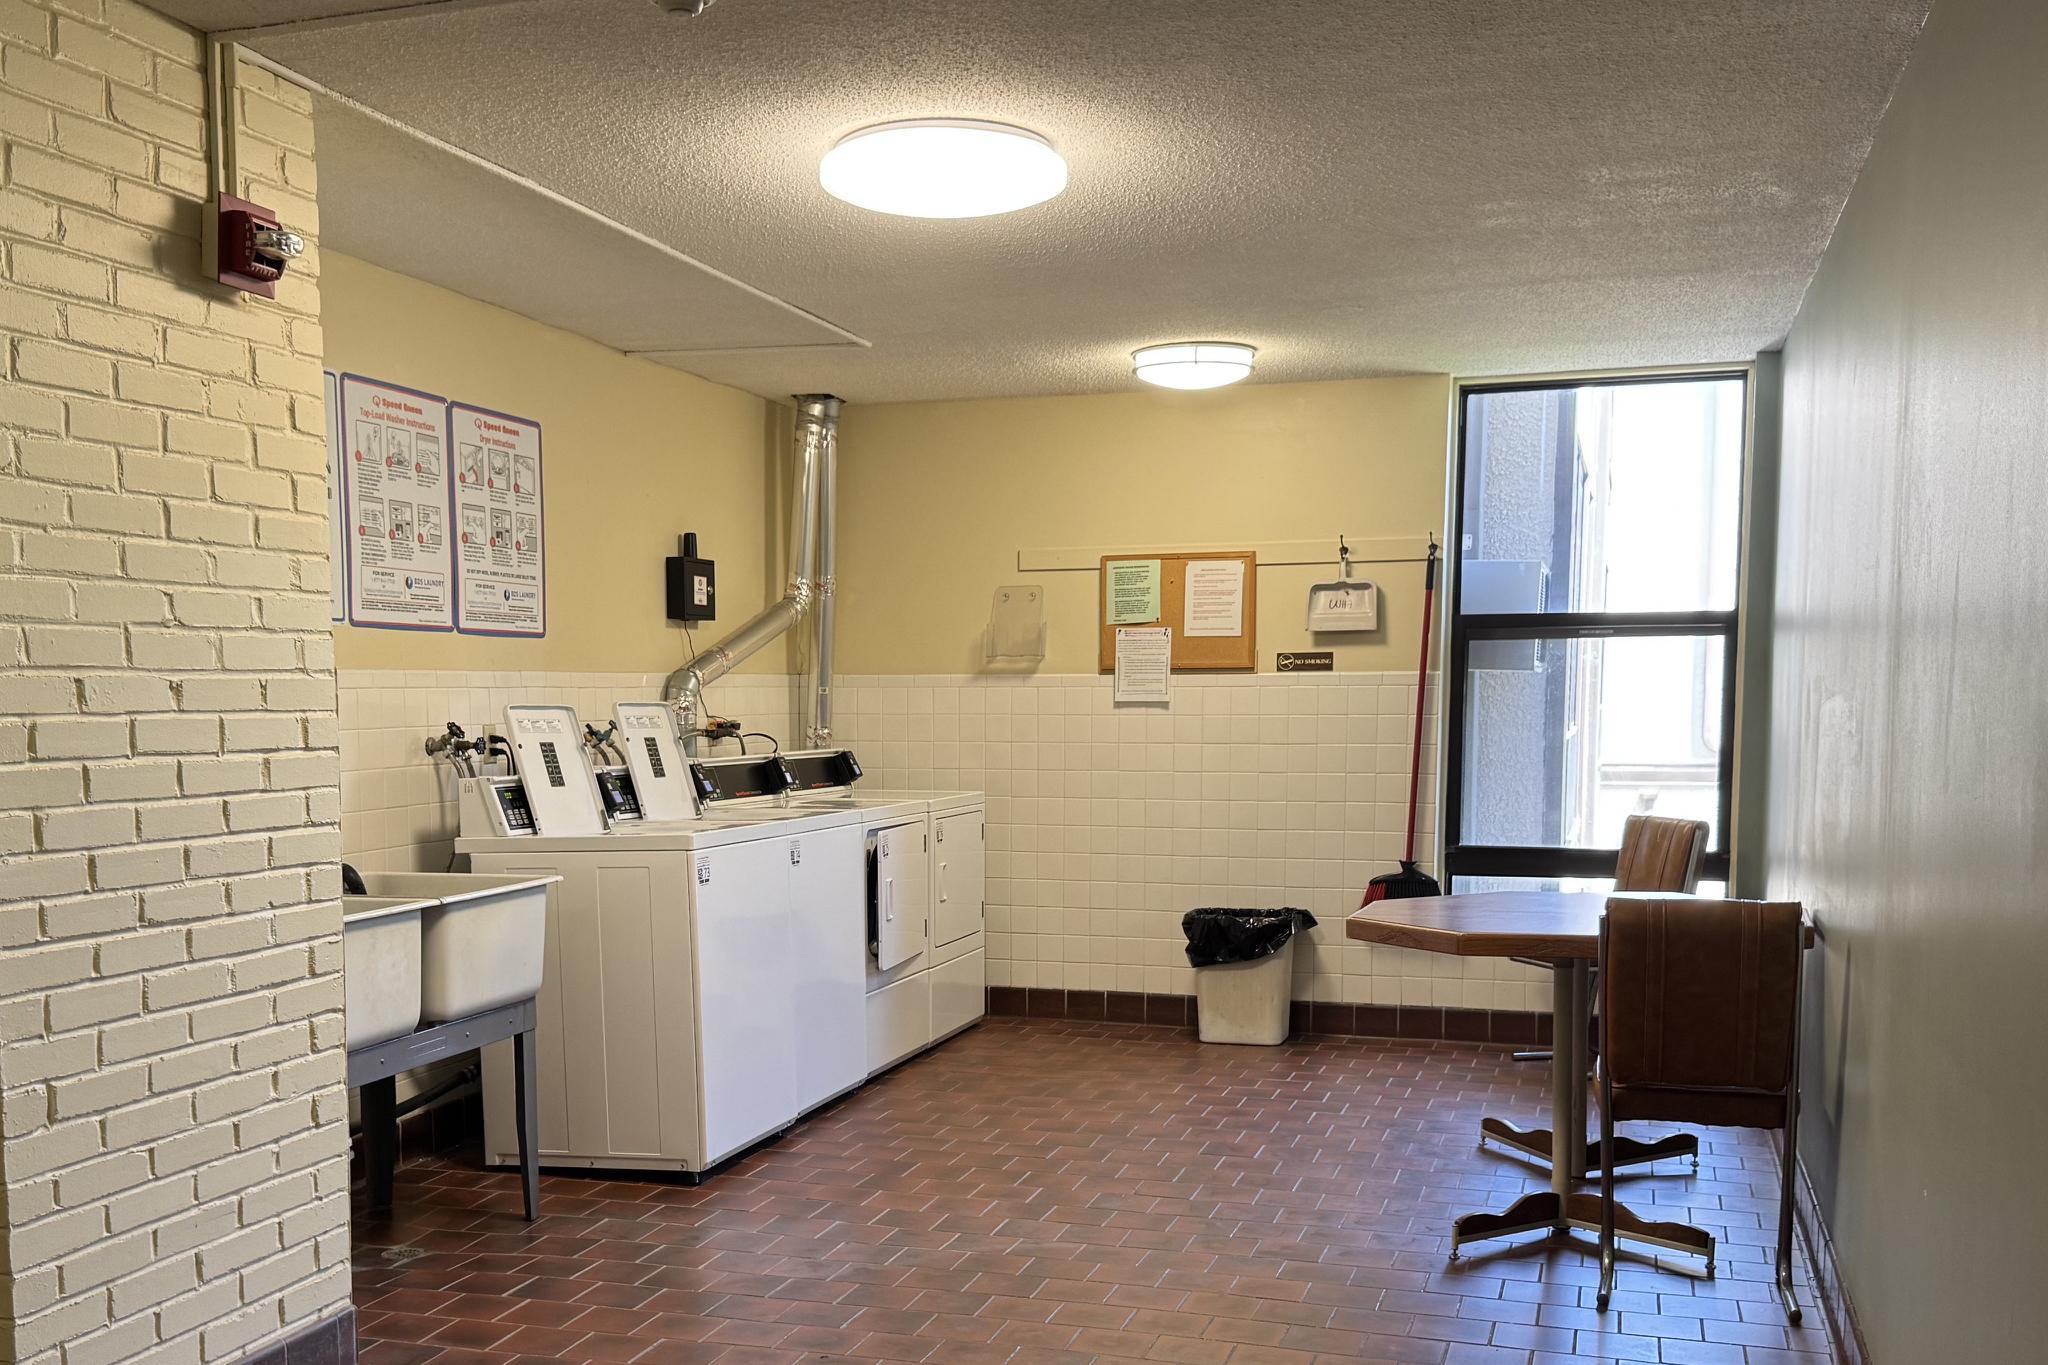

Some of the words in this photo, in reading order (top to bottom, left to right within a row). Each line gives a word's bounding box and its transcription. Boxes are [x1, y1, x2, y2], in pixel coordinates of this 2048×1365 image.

[381, 398, 402, 411] Speed
[360, 407, 385, 420] Top-Load
[386, 412, 406, 425] Washer
[406, 418, 436, 432] Instructions
[492, 437, 516, 450] Instructions
[423, 578, 444, 588] LAUNDRY
[1304, 657, 1332, 665] SMOKING
